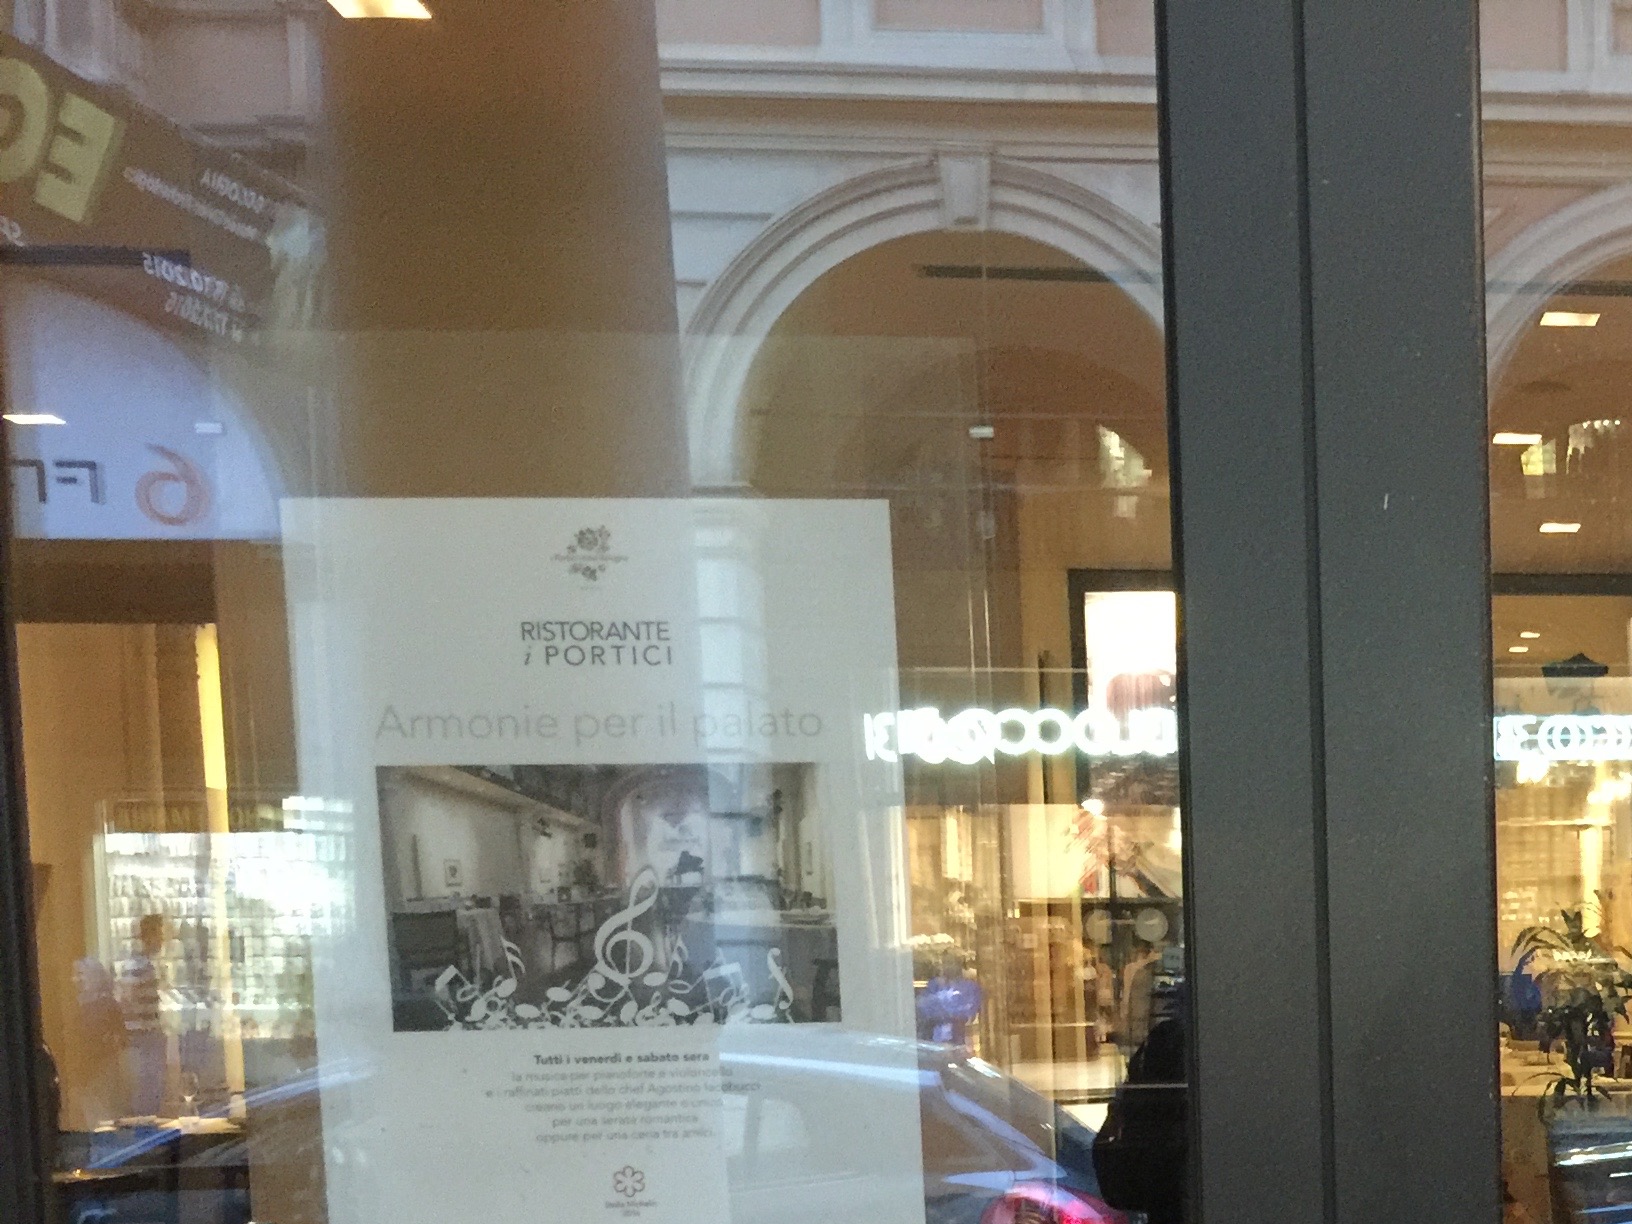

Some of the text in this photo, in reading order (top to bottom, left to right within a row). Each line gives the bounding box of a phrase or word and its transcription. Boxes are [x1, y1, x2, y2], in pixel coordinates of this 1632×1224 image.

[520, 621, 671, 642] RISTORANTE
[545, 644, 674, 667] PORTICI
[376, 702, 824, 750] Armonie per il palato
[533, 1054, 563, 1065] Tutti
[637, 1052, 680, 1063] sabato
[683, 1053, 709, 1063] sera
